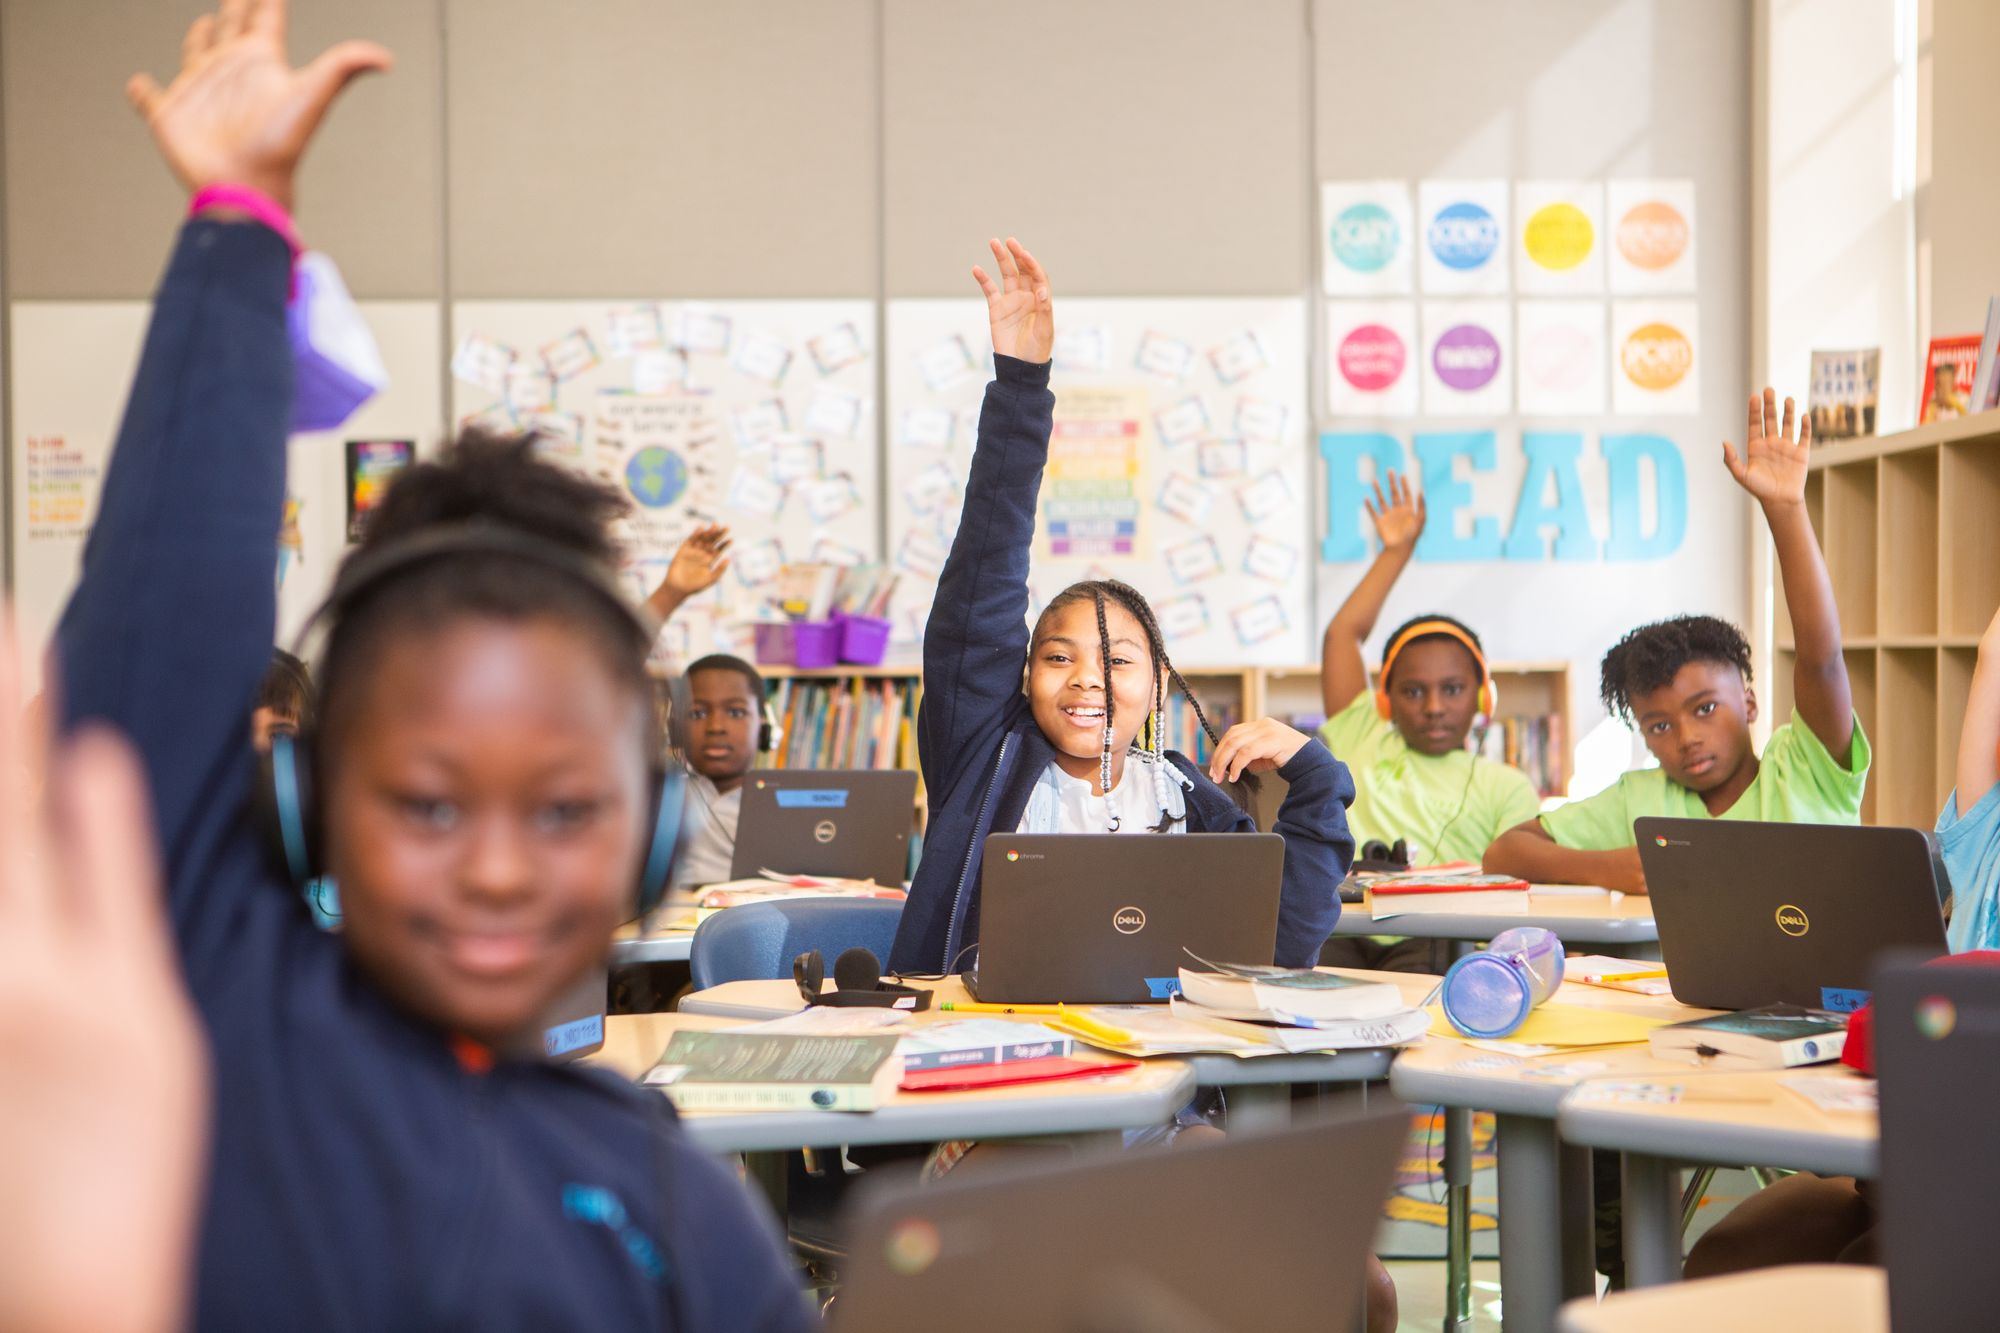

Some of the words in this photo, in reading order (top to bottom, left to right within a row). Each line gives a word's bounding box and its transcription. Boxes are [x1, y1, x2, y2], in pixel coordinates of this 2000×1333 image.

[1319, 431, 1688, 562] READ
[1117, 916, 1143, 925] DELL
[1779, 915, 1807, 926] DELL
